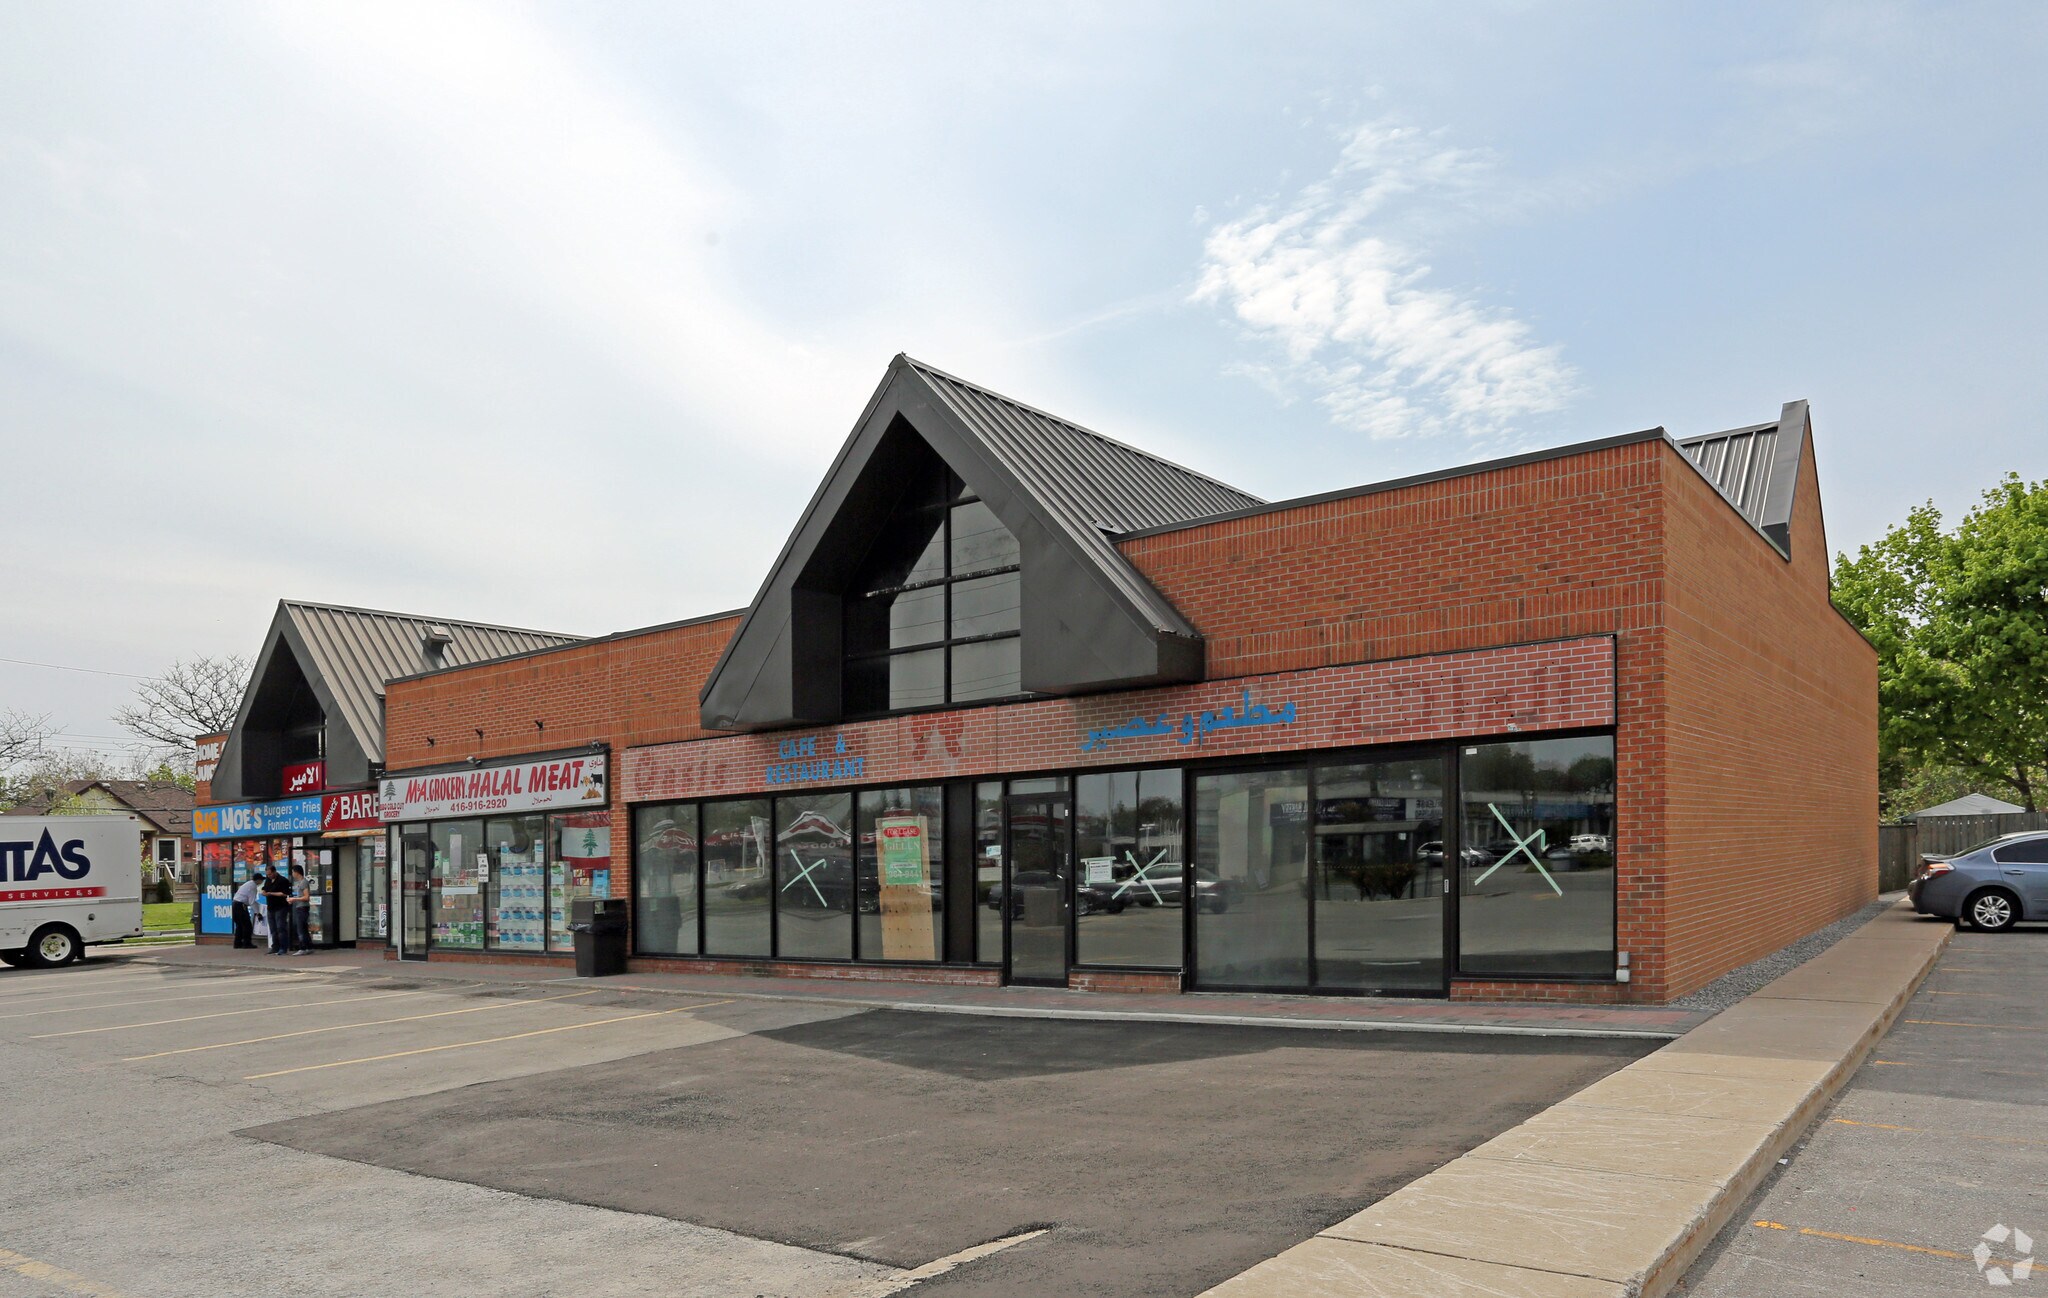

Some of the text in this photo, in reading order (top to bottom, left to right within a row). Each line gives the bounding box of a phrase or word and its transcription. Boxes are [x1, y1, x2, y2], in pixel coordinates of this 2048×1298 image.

[1080, 712, 1174, 751] عصير
[1199, 690, 1296, 746] مطعم
[195, 743, 220, 762] HOME
[779, 733, 846, 760] CAFE &
[468, 767, 522, 799] HALAL
[528, 760, 584, 793] MEAT
[765, 757, 865, 785] RESTAURANT
[264, 802, 320, 818] Burgers Fries
[450, 798, 507, 812] 416-916-2920
[193, 807, 262, 835] BIG MOE'S
[268, 818, 317, 831] Funnel Cakes
[0, 826, 91, 882] TAS
[8, 889, 93, 899] SERVICES
[207, 885, 232, 899] FRESH
